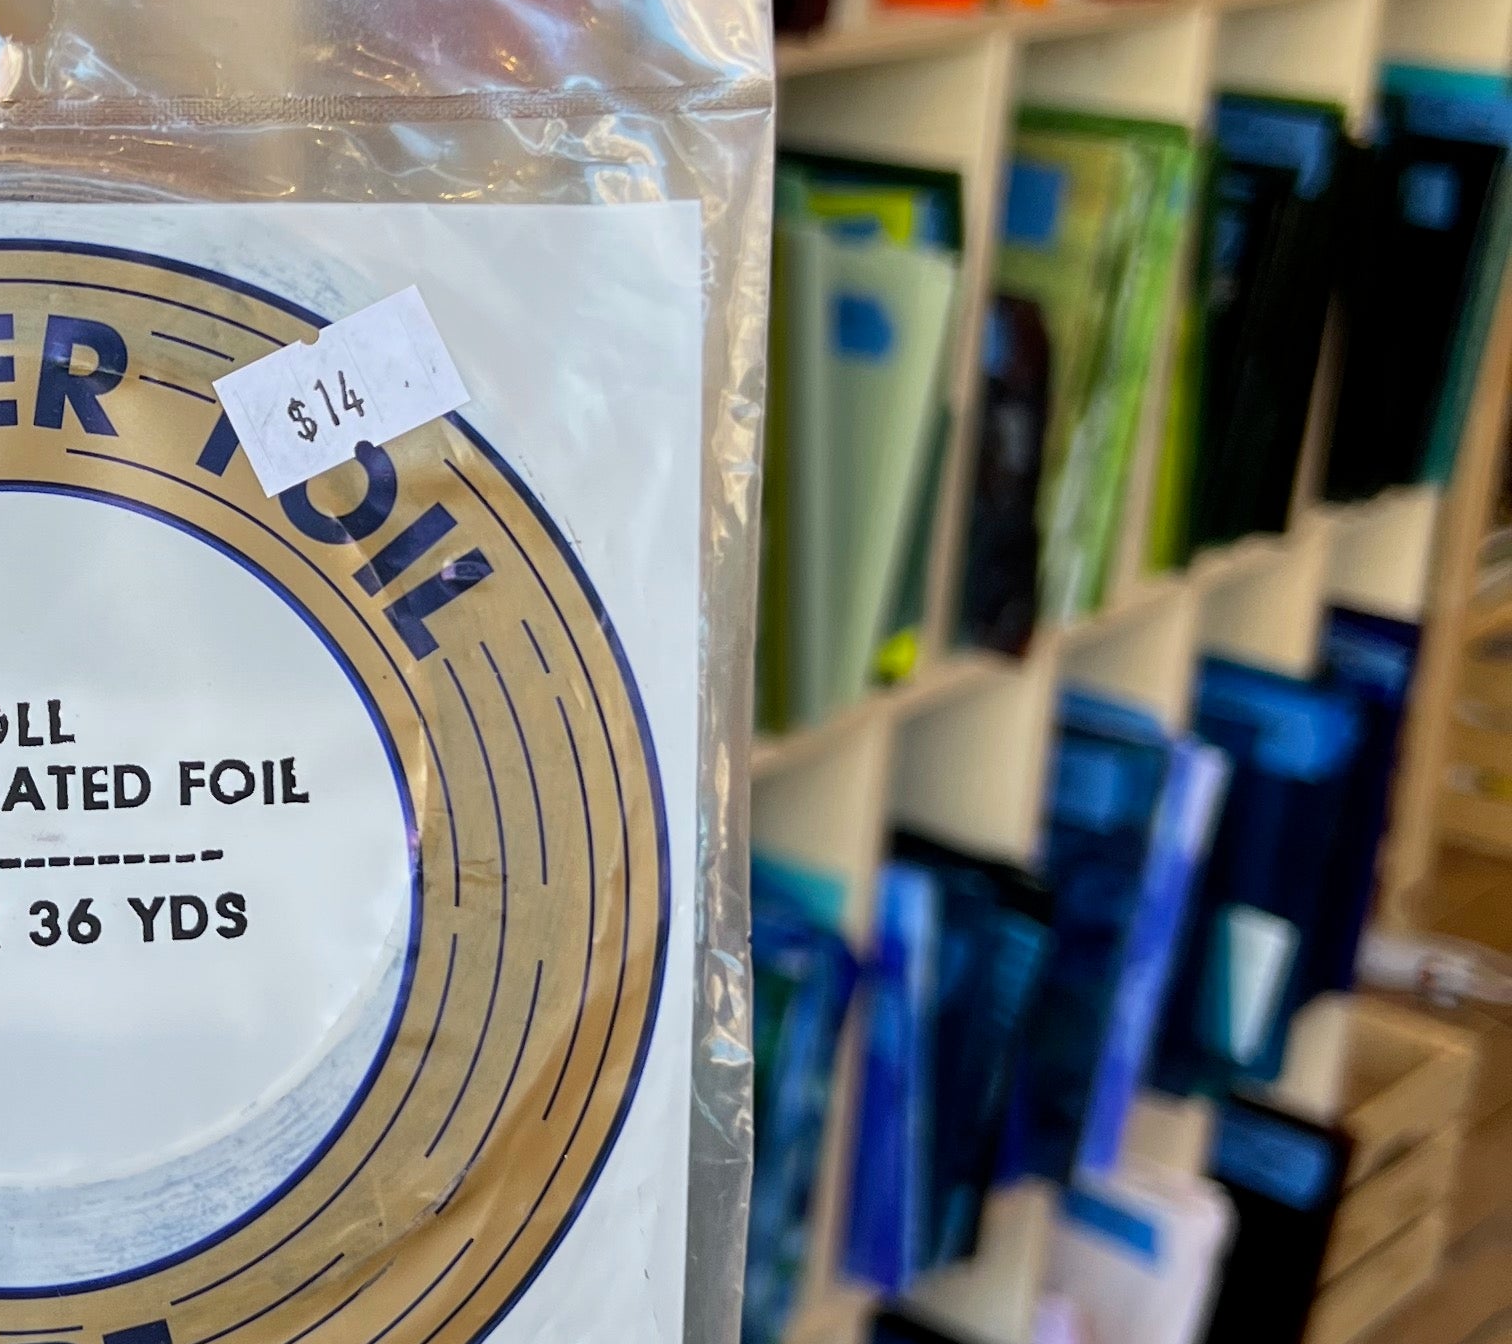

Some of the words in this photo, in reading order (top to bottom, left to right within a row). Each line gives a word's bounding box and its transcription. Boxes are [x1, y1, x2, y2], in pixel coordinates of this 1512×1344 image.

[287, 370, 365, 443] $14
[178, 756, 311, 807] FOIL
[28, 897, 103, 948] 36
[127, 890, 249, 943] YDS
